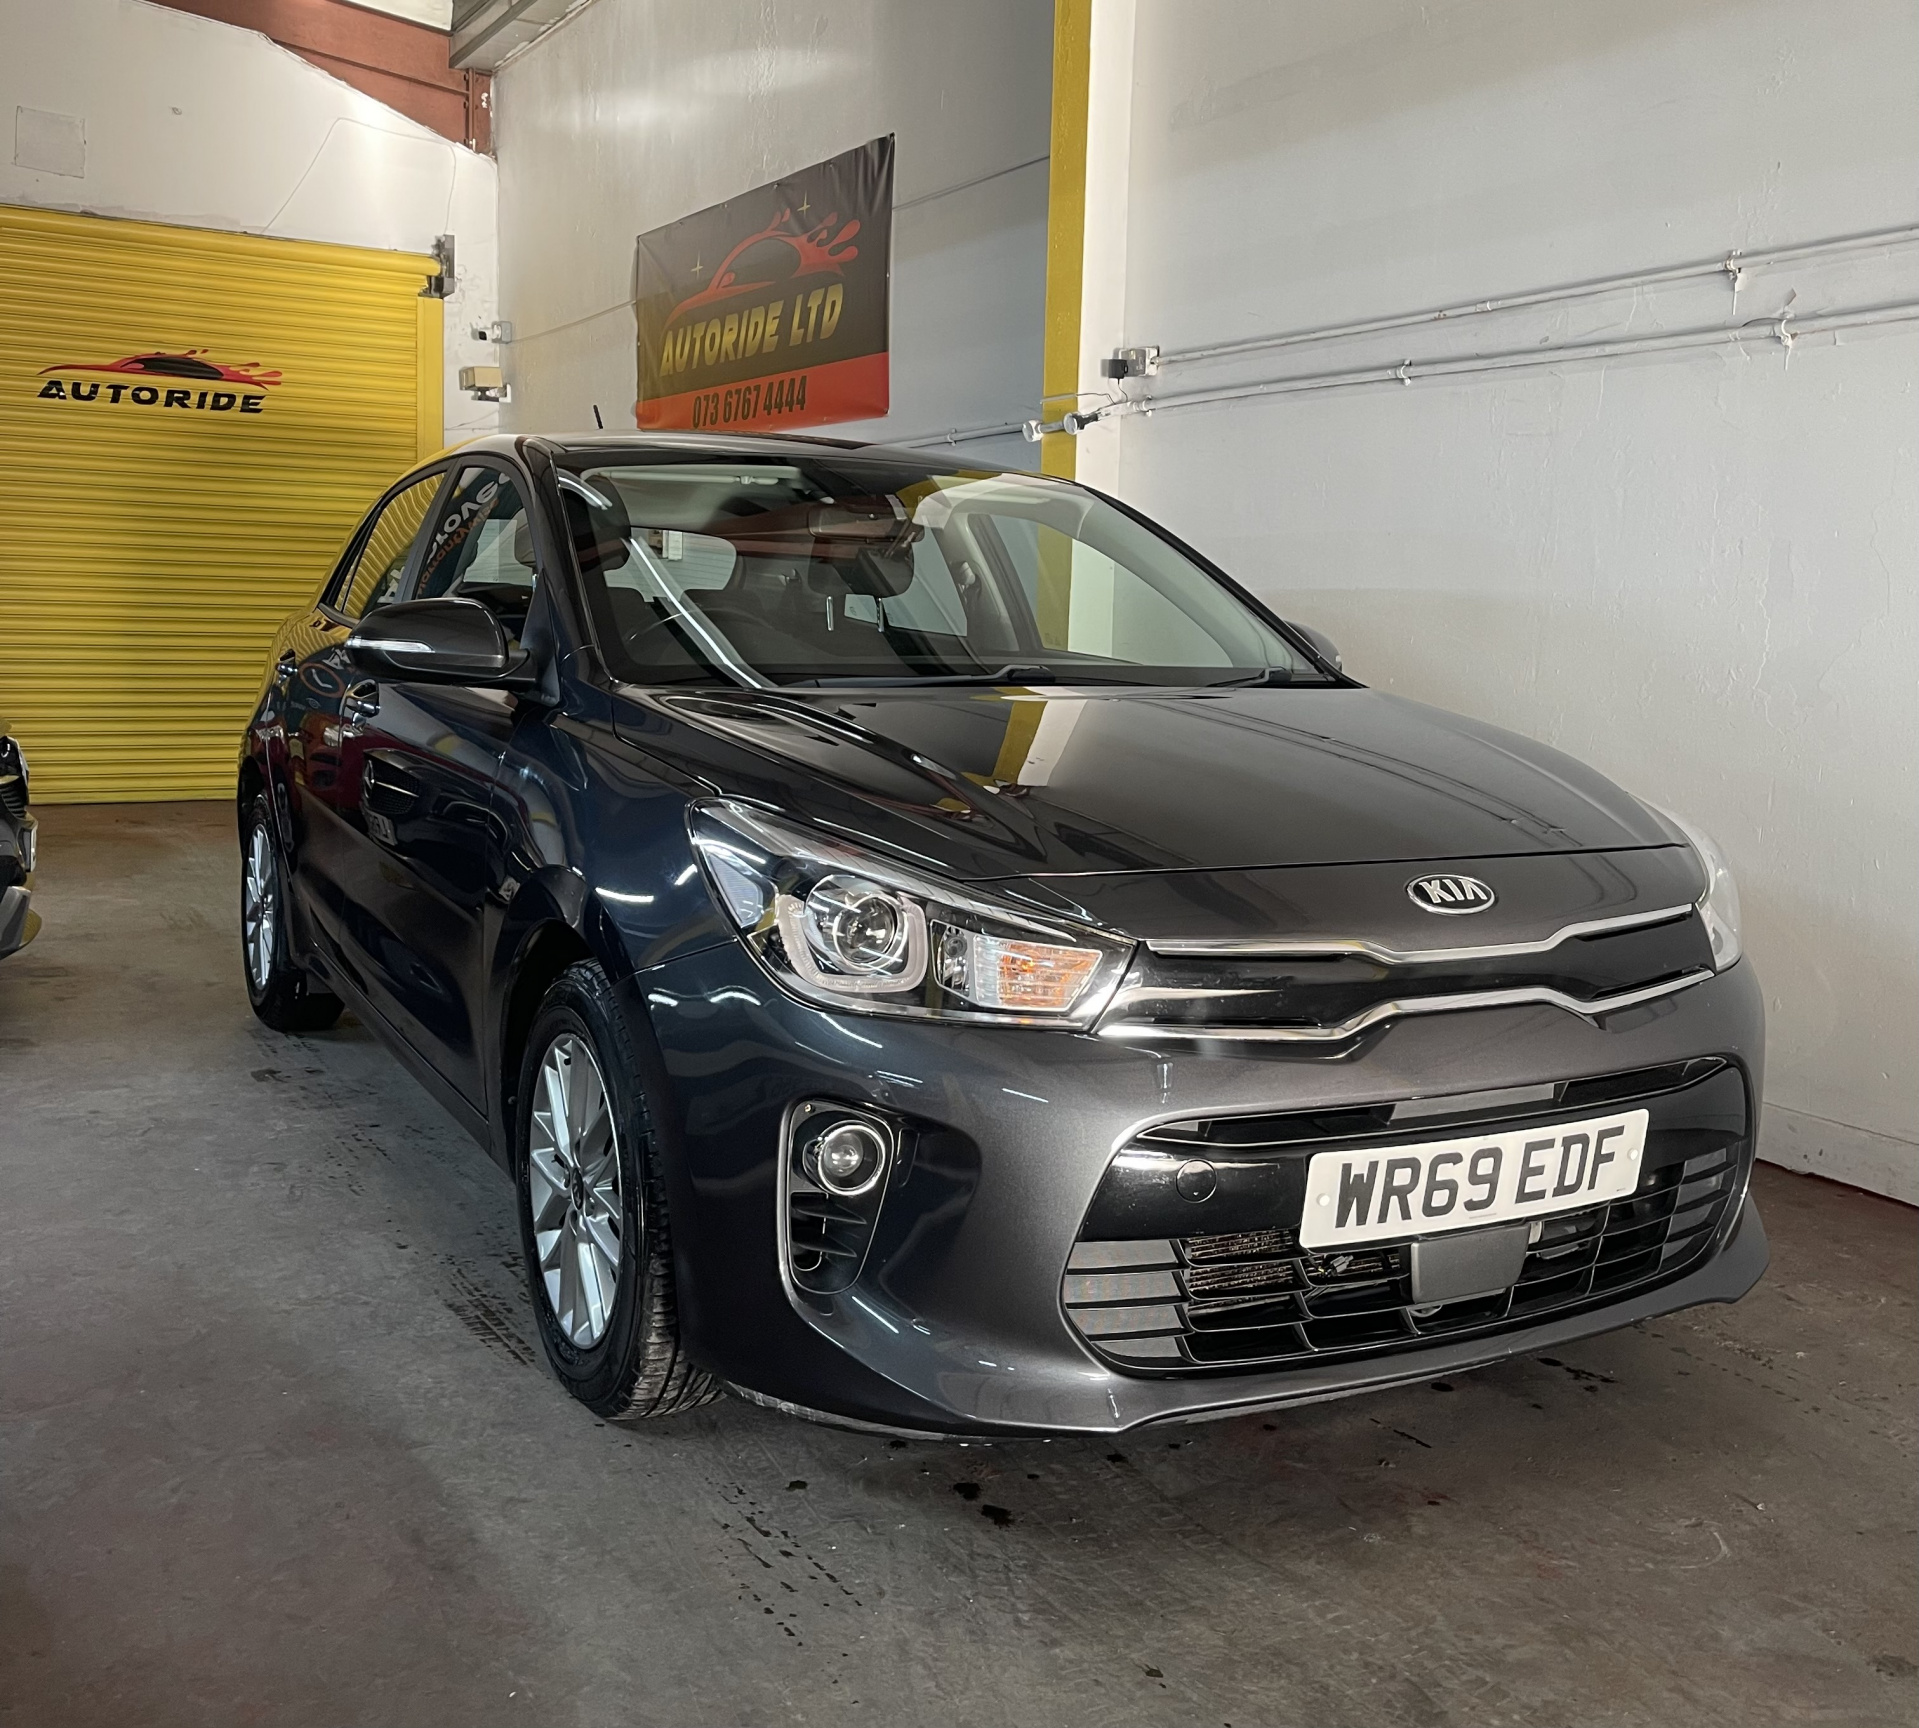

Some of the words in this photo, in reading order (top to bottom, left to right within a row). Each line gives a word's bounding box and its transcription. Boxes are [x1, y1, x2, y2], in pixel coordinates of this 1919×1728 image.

[660, 300, 784, 377] AUTORIDE
[789, 283, 844, 347] LTD
[37, 380, 267, 413] AUTORIDE
[692, 390, 720, 429] 073
[723, 384, 761, 423] 6767
[763, 375, 808, 416] 4444
[1419, 879, 1488, 904] KIA
[1335, 1146, 1503, 1228] WR69
[1515, 1125, 1626, 1204] EDF
